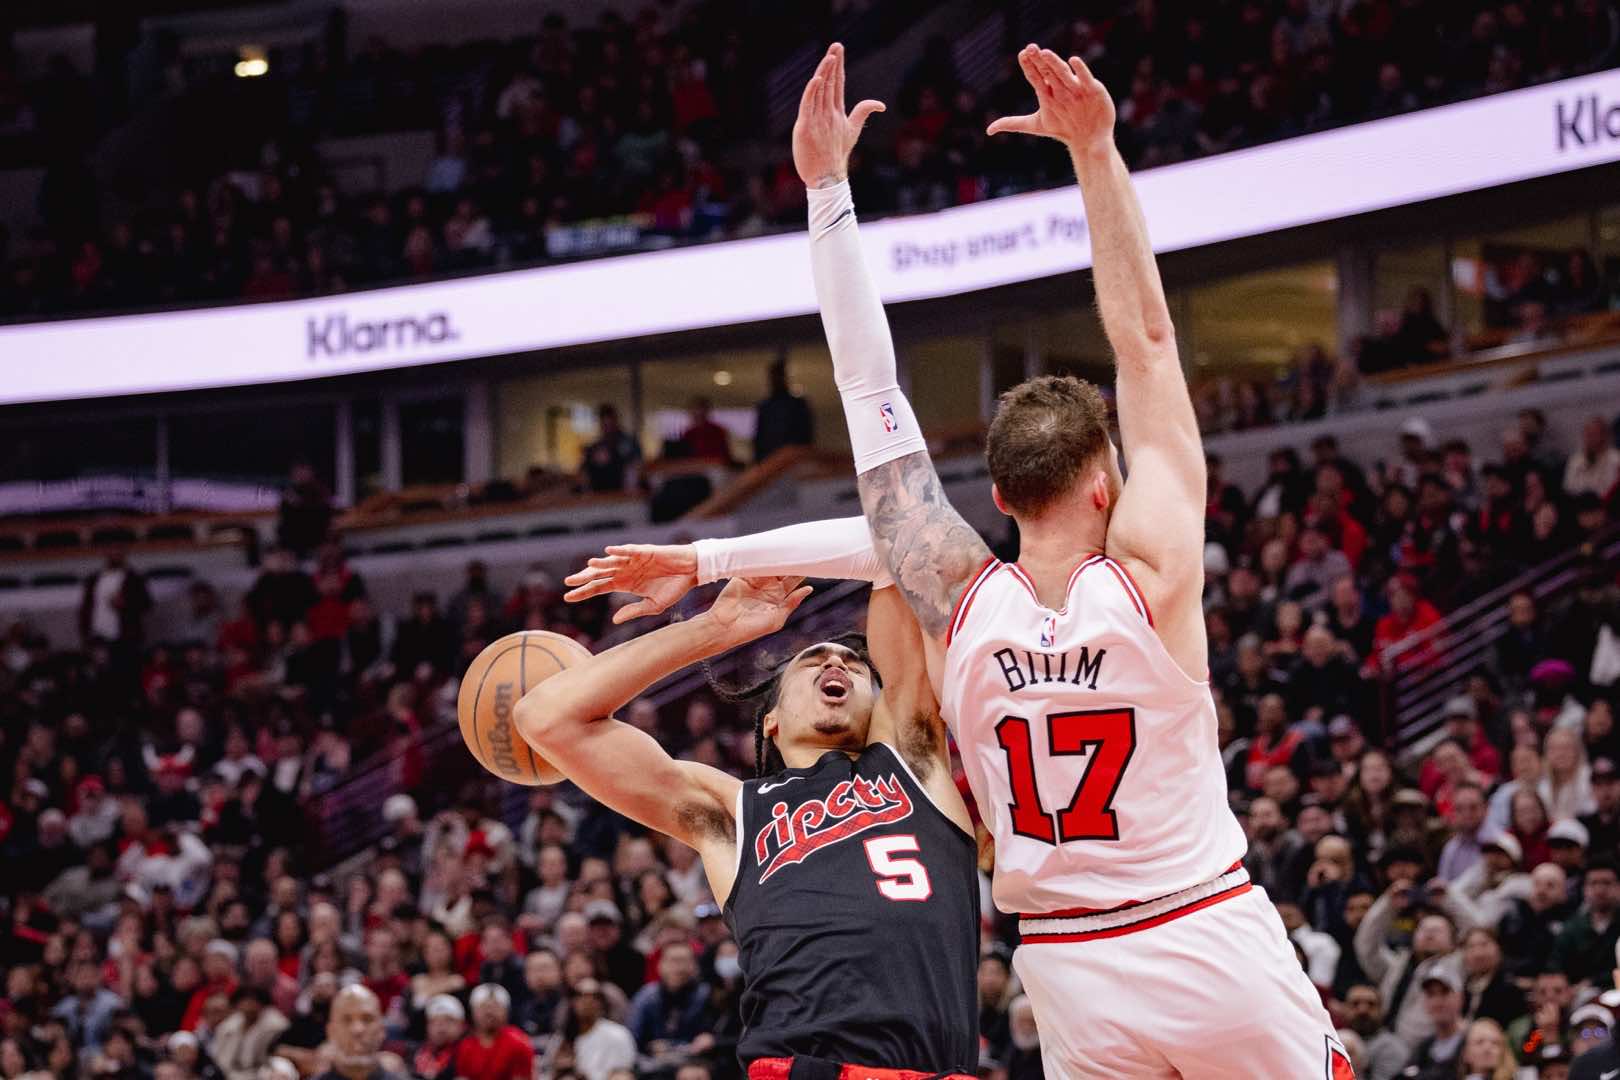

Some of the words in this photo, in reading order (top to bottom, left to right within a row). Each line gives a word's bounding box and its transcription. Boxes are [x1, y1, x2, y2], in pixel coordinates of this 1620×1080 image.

[892, 242, 957, 271] Shop
[993, 646, 1107, 692] BITIM
[488, 681, 522, 775] Wilson
[994, 707, 1137, 847] 17
[755, 772, 914, 884] ripcty
[863, 834, 933, 902] 5
